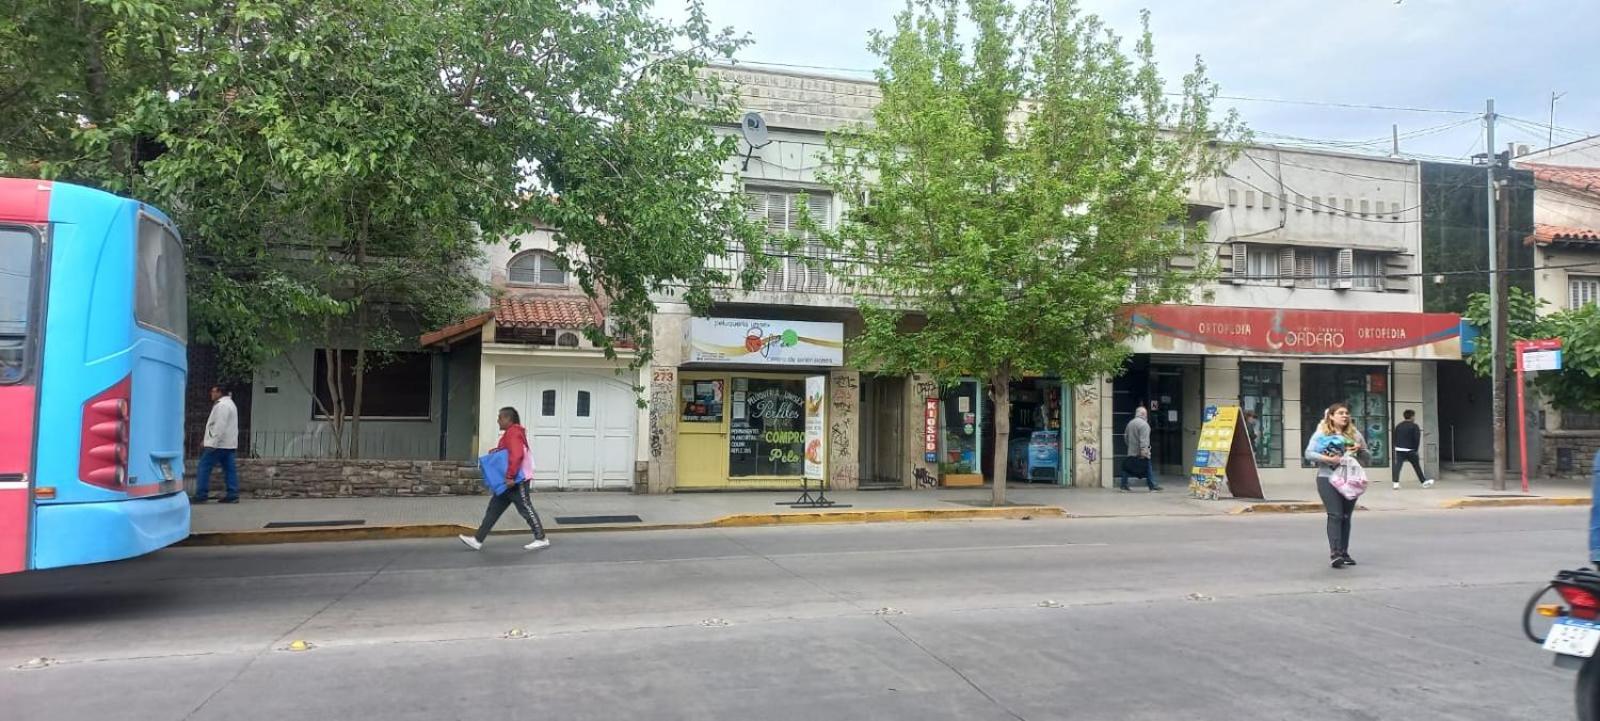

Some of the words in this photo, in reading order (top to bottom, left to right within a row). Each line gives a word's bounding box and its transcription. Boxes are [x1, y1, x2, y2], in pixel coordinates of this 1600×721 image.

[1199, 322, 1251, 336] ORTOPEDIA
[1358, 327, 1406, 339] ORTOPEDIA
[654, 372, 673, 381] 273
[747, 387, 780, 406] PELUQUERIA
[926, 401, 936, 450] KIOSCO
[765, 431, 805, 444] COMPRO
